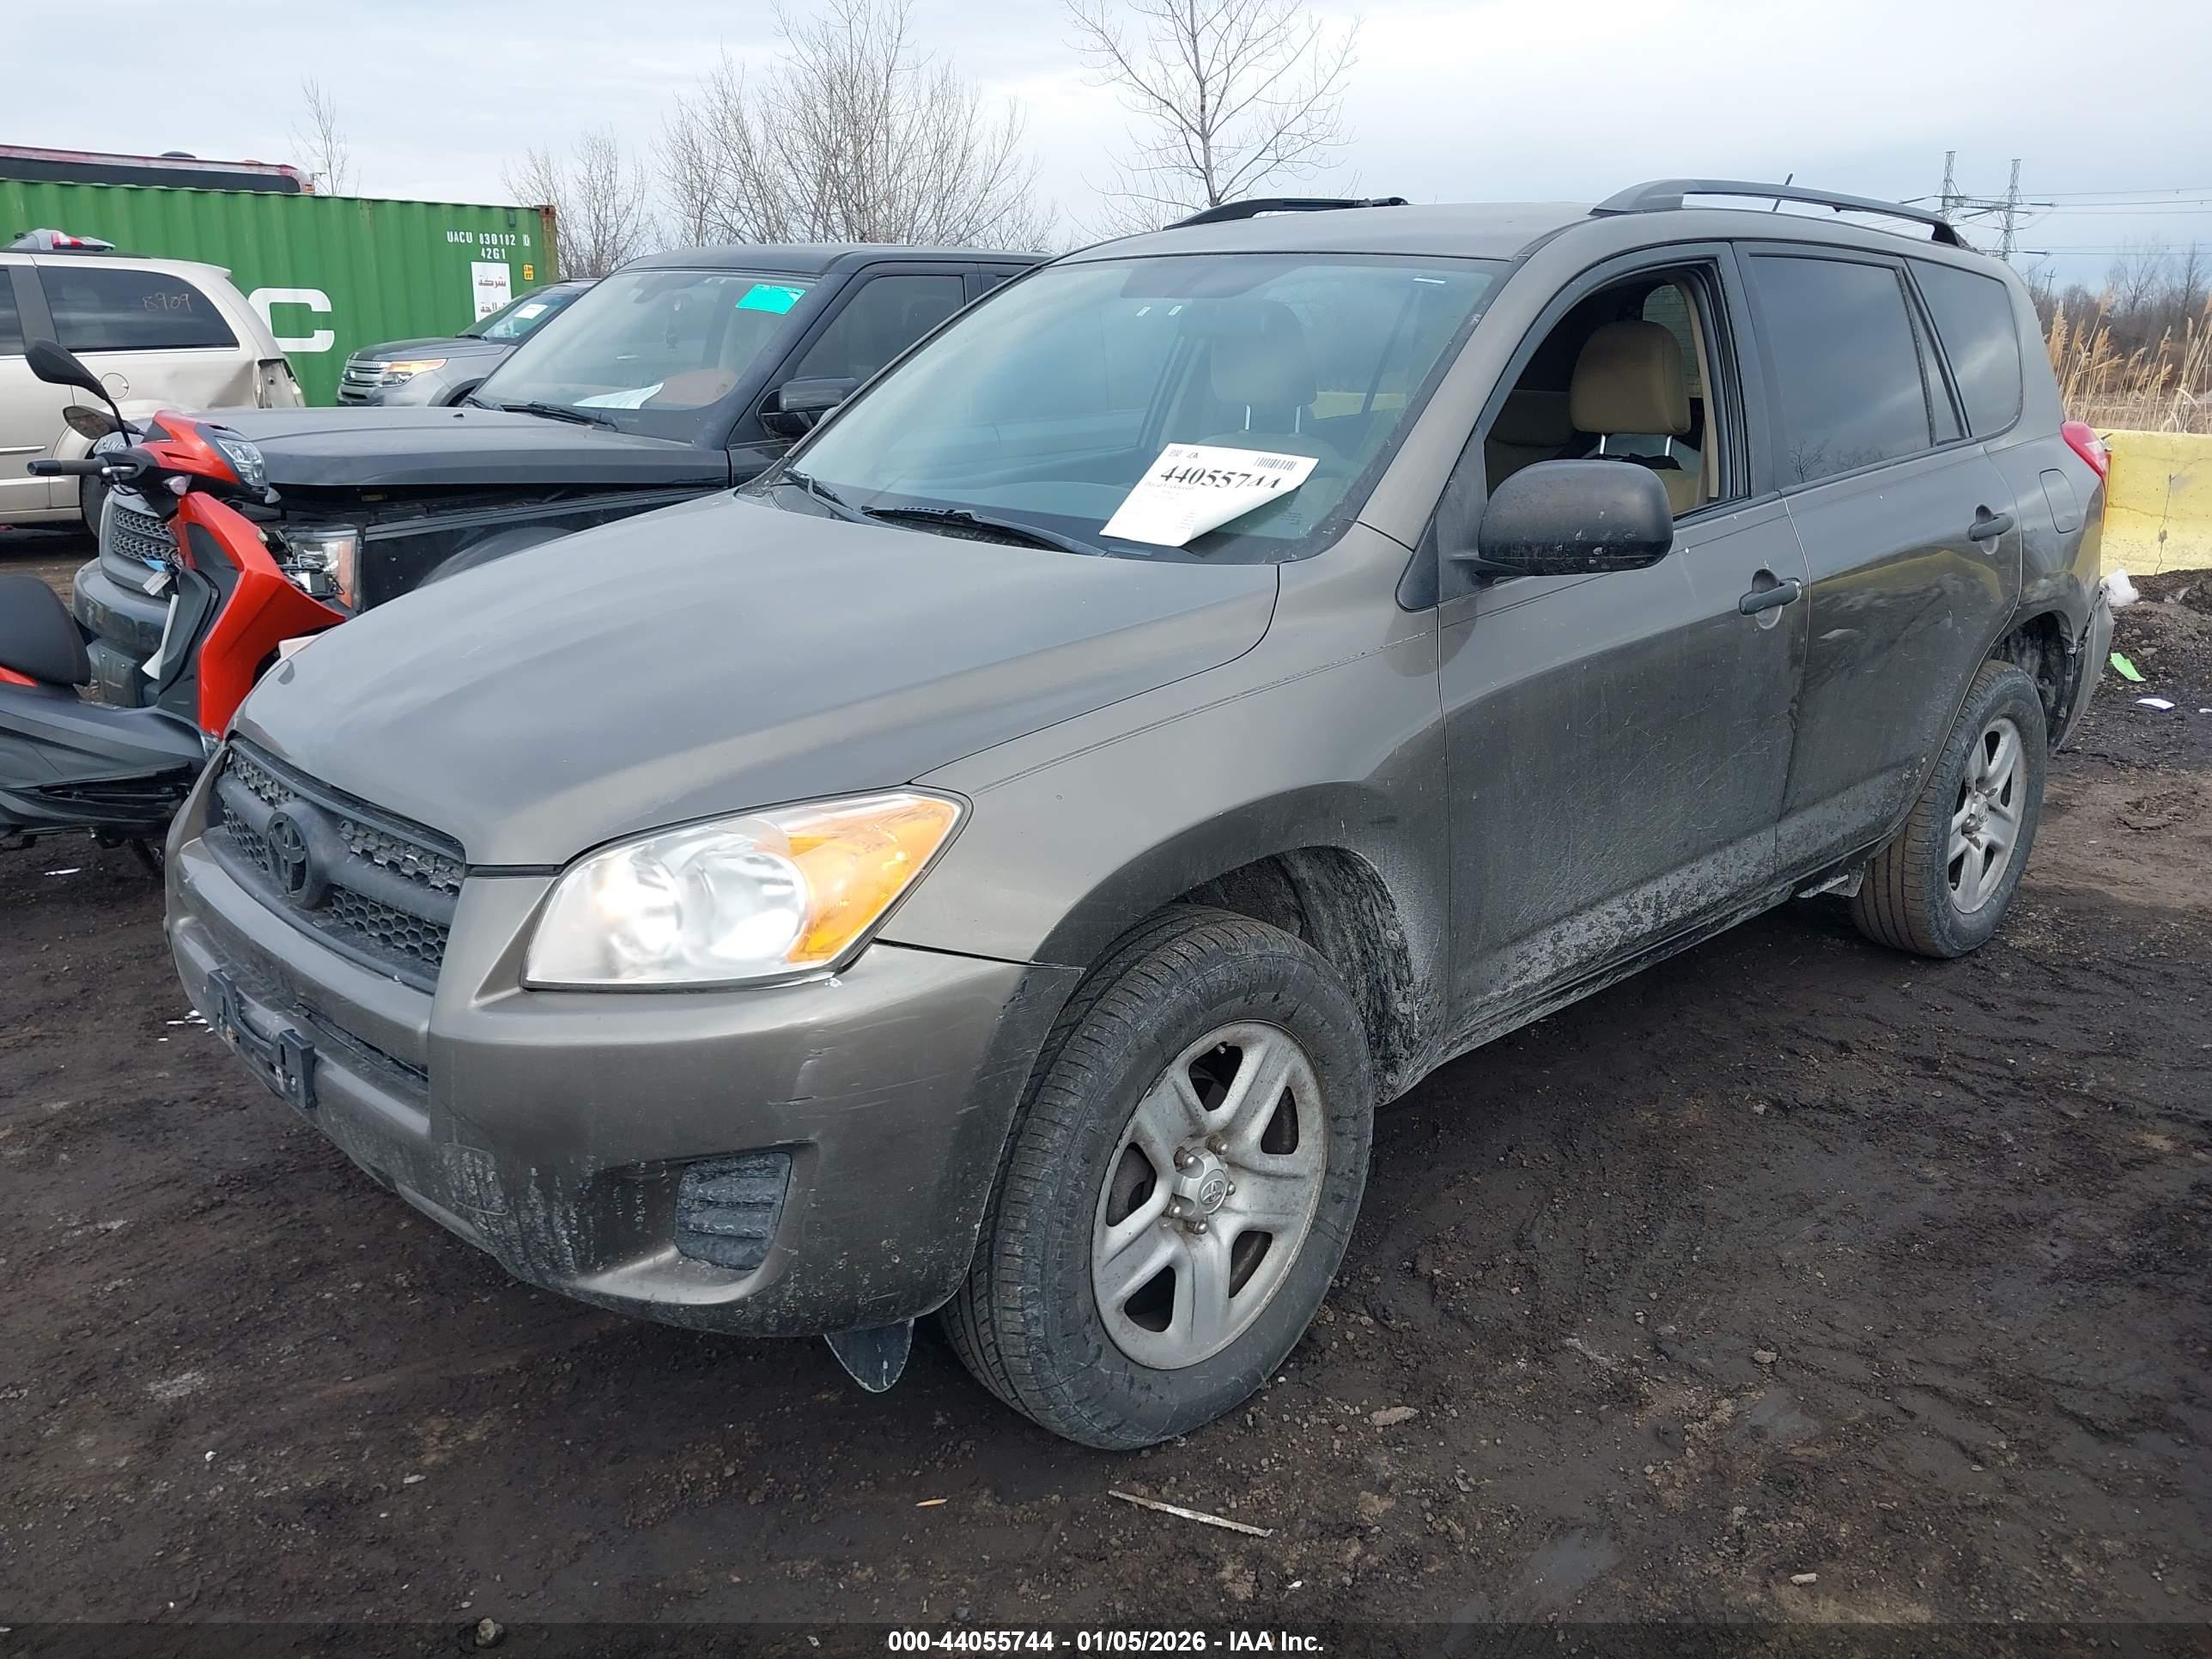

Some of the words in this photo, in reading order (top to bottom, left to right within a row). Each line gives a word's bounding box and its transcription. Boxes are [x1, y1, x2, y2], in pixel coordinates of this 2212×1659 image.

[447, 231, 473, 244] UACU
[479, 233, 516, 246] 830182
[481, 247, 506, 259] 42G1
